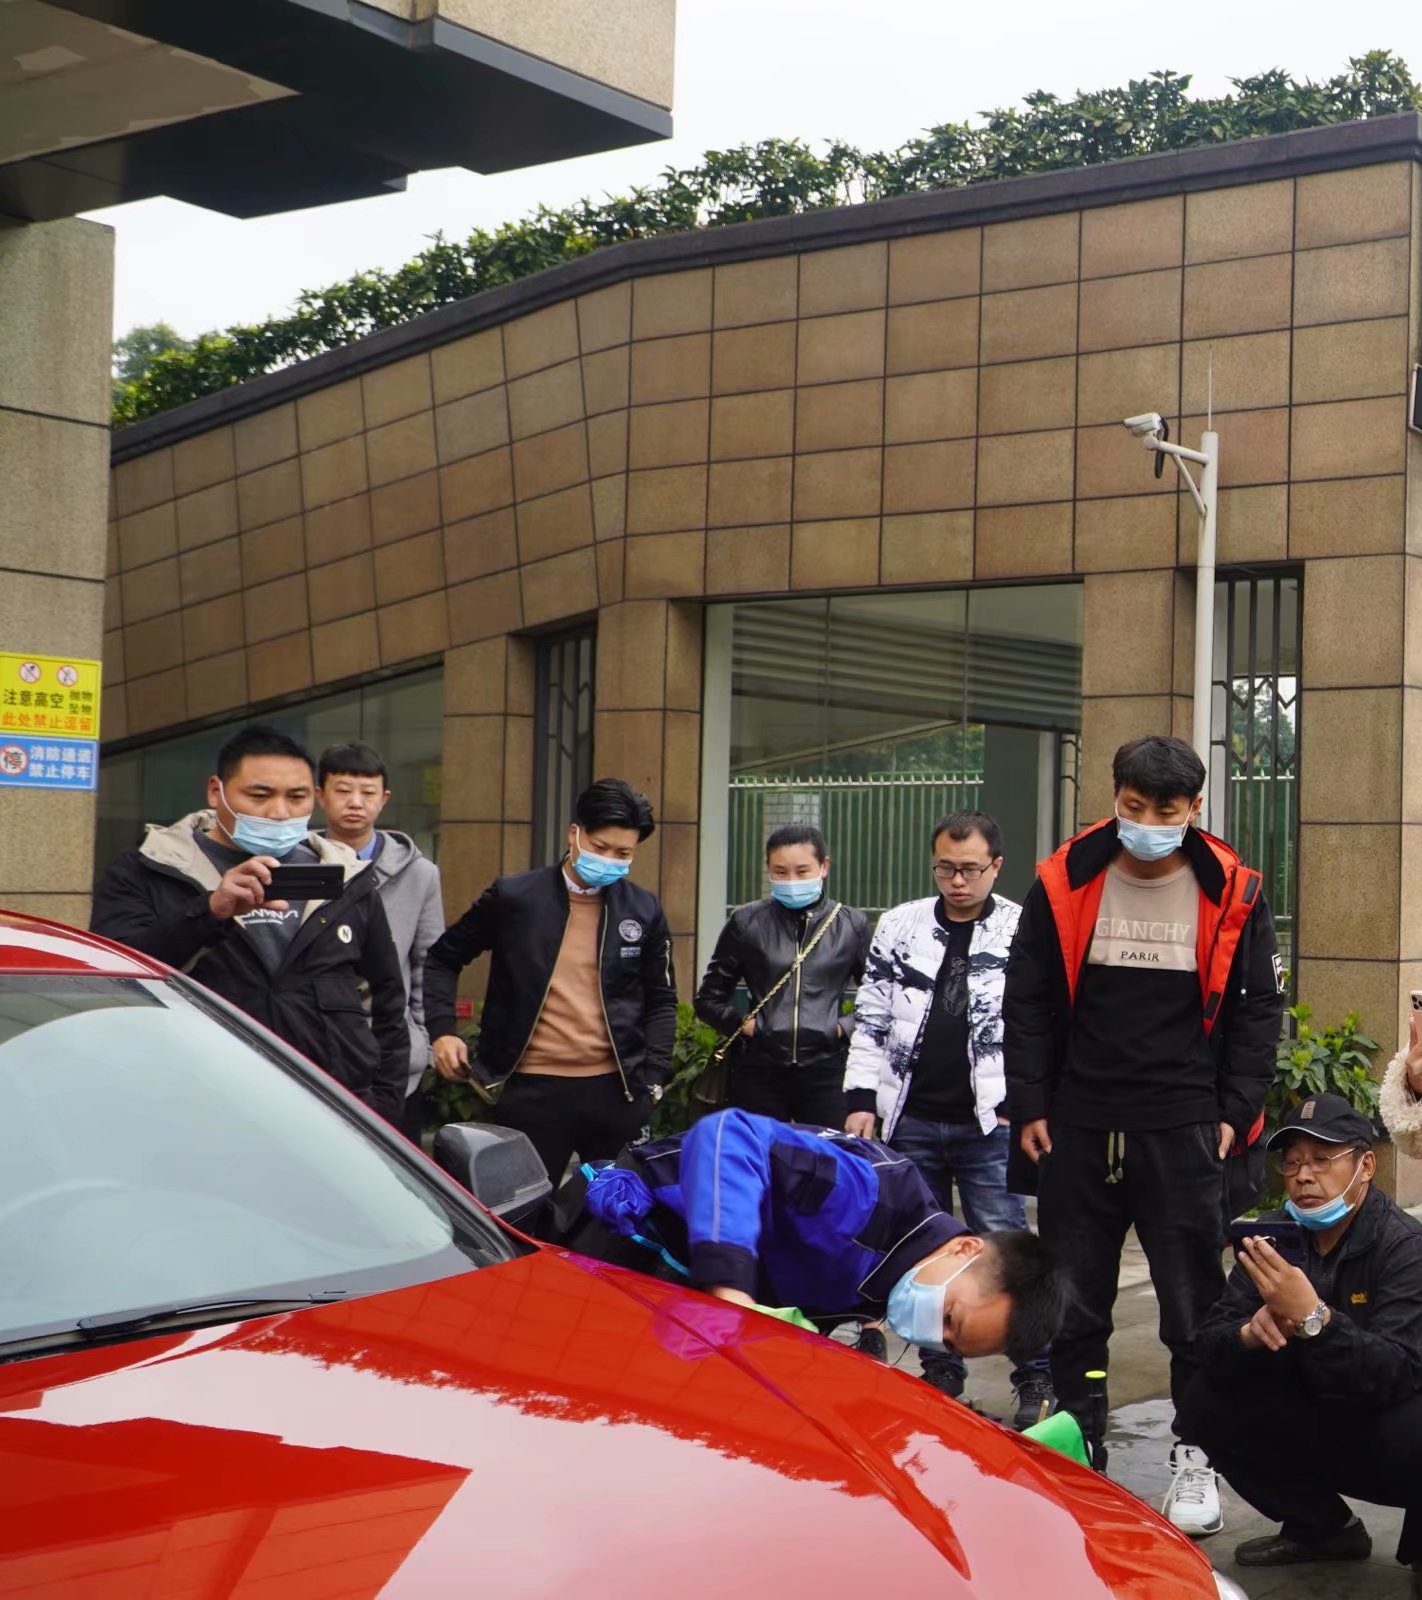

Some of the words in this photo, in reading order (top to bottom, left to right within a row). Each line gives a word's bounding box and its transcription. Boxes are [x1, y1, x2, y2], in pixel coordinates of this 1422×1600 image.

[2, 711, 92, 732] 此处禁止逗留
[30, 745, 92, 764] 消防通道
[28, 762, 91, 781] 禁止停车
[1095, 917, 1191, 943] GIANCHY
